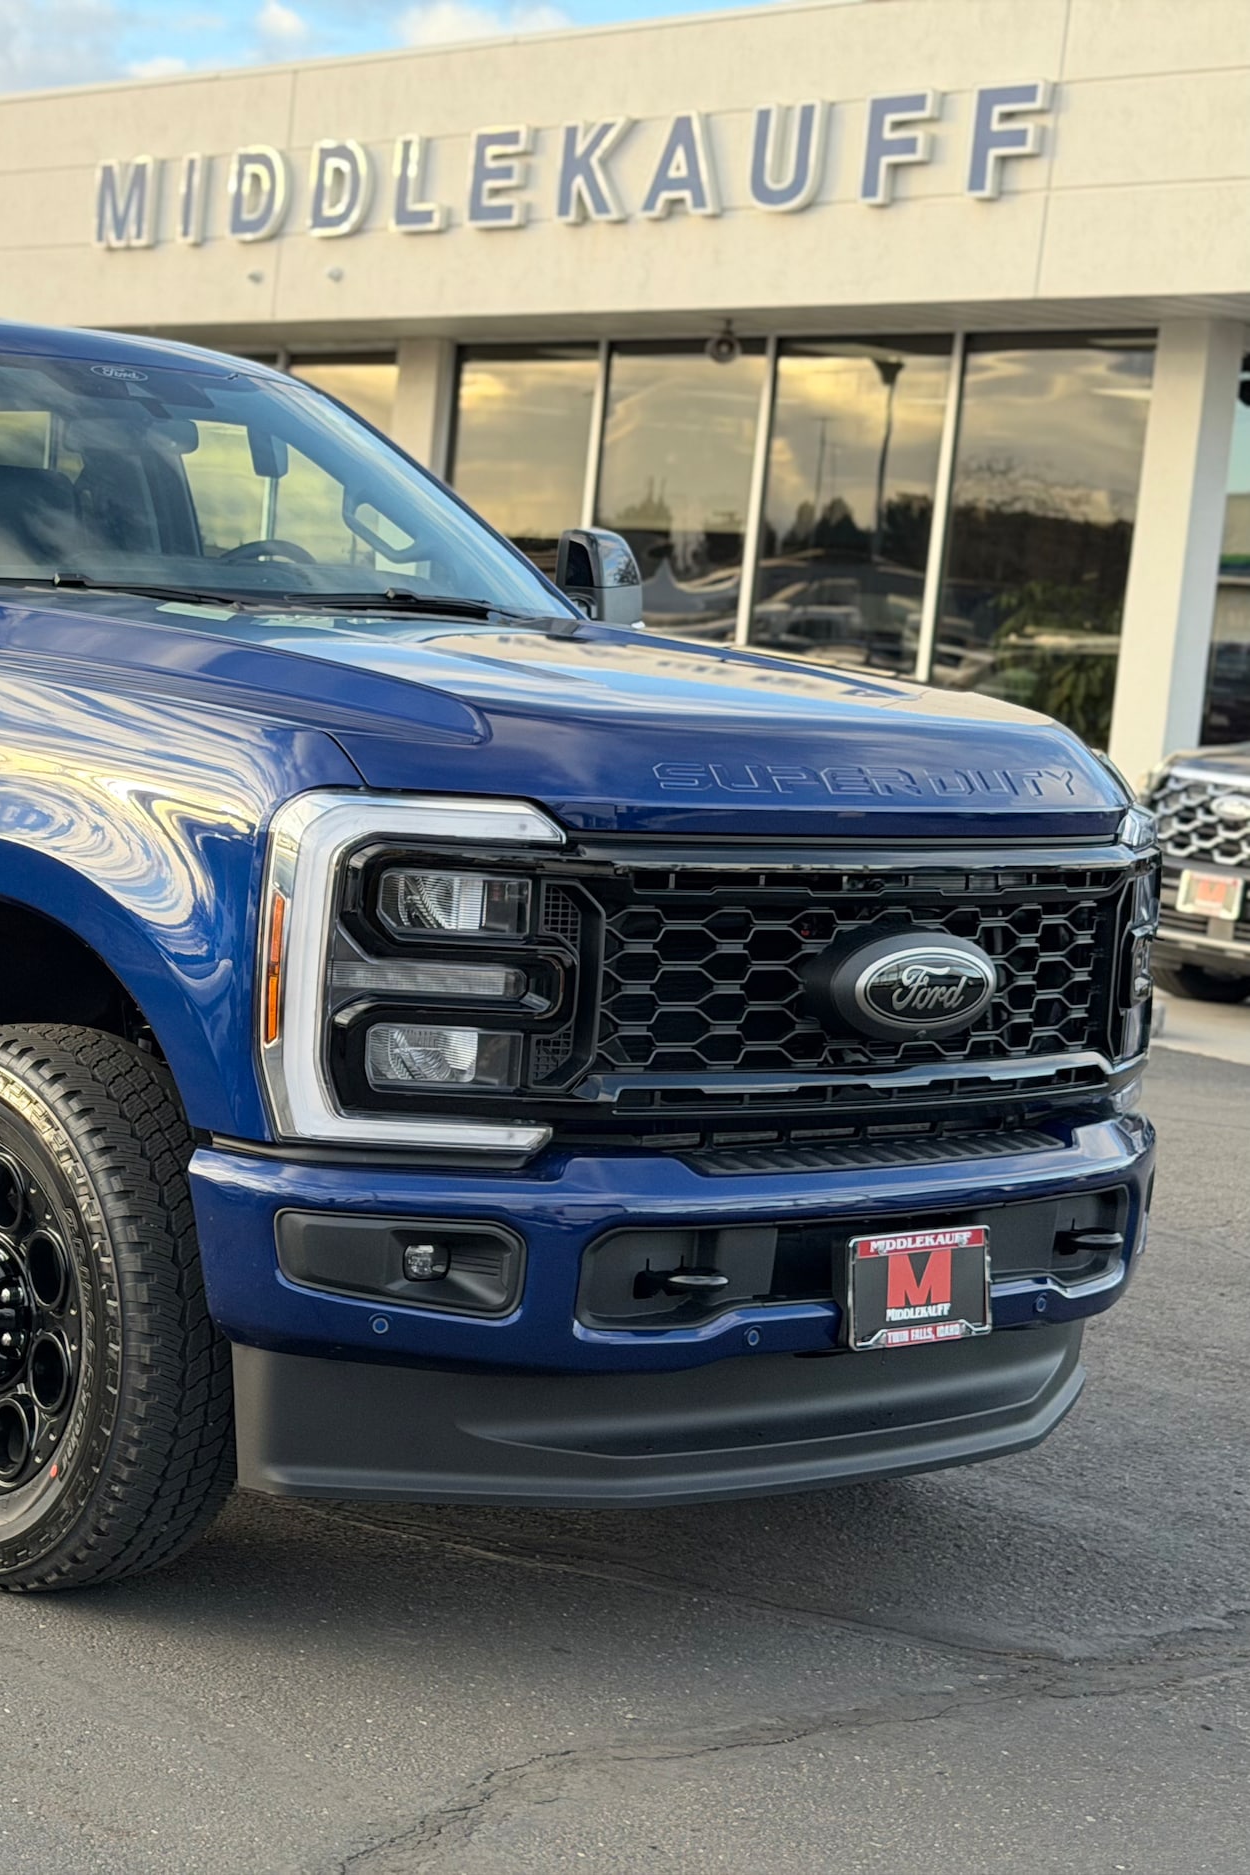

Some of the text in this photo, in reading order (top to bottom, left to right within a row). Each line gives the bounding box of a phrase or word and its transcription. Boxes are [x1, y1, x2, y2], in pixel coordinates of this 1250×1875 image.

[94, 78, 1053, 249] MIDDLEKAUFF
[652, 762, 1077, 798] SUPER DUTY
[892, 965, 967, 1011] Ford
[869, 1231, 972, 1254] MIDDLEKAUFF
[887, 1250, 952, 1308] M
[886, 1302, 951, 1322] MIDDLEKAUFF
